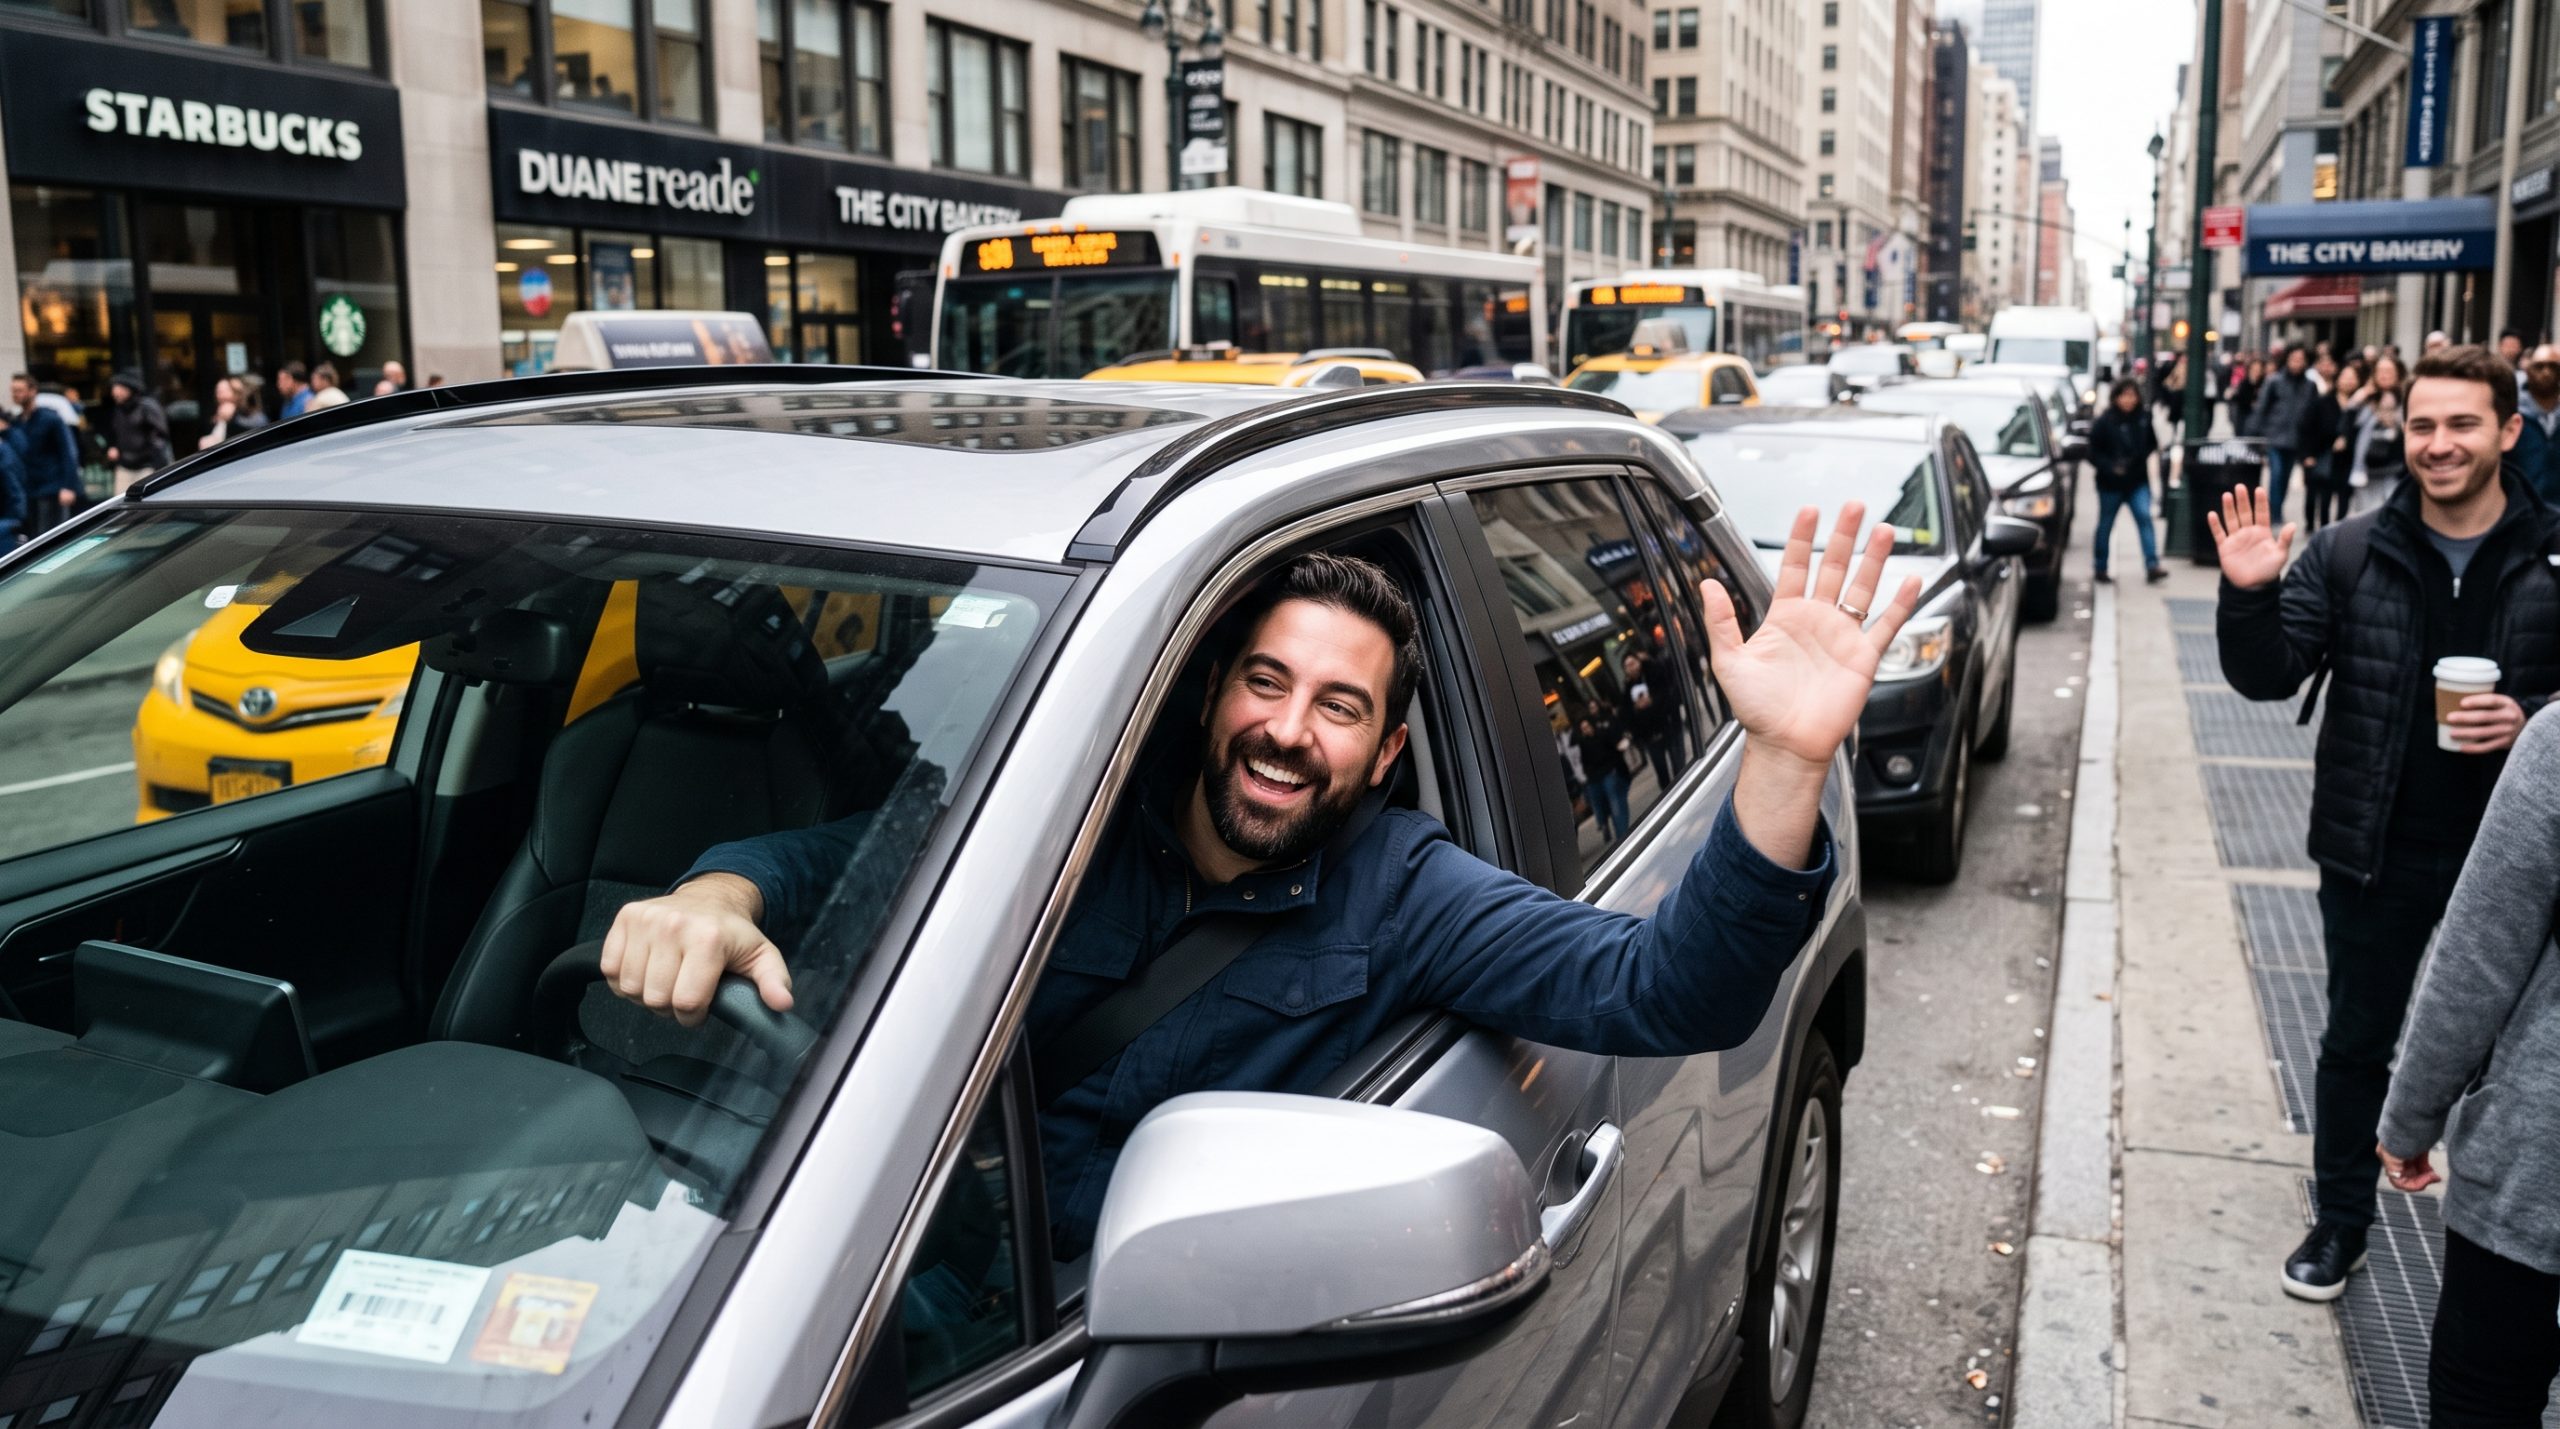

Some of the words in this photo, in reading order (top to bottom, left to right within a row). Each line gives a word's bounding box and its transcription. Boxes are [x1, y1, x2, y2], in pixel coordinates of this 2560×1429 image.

[85, 87, 363, 162] STARBUCKS
[835, 185, 886, 228] THE
[887, 191, 940, 232] CITY
[2268, 243, 2310, 265] THE
[2314, 241, 2366, 264] CITY
[2369, 238, 2464, 263] BAKERY
